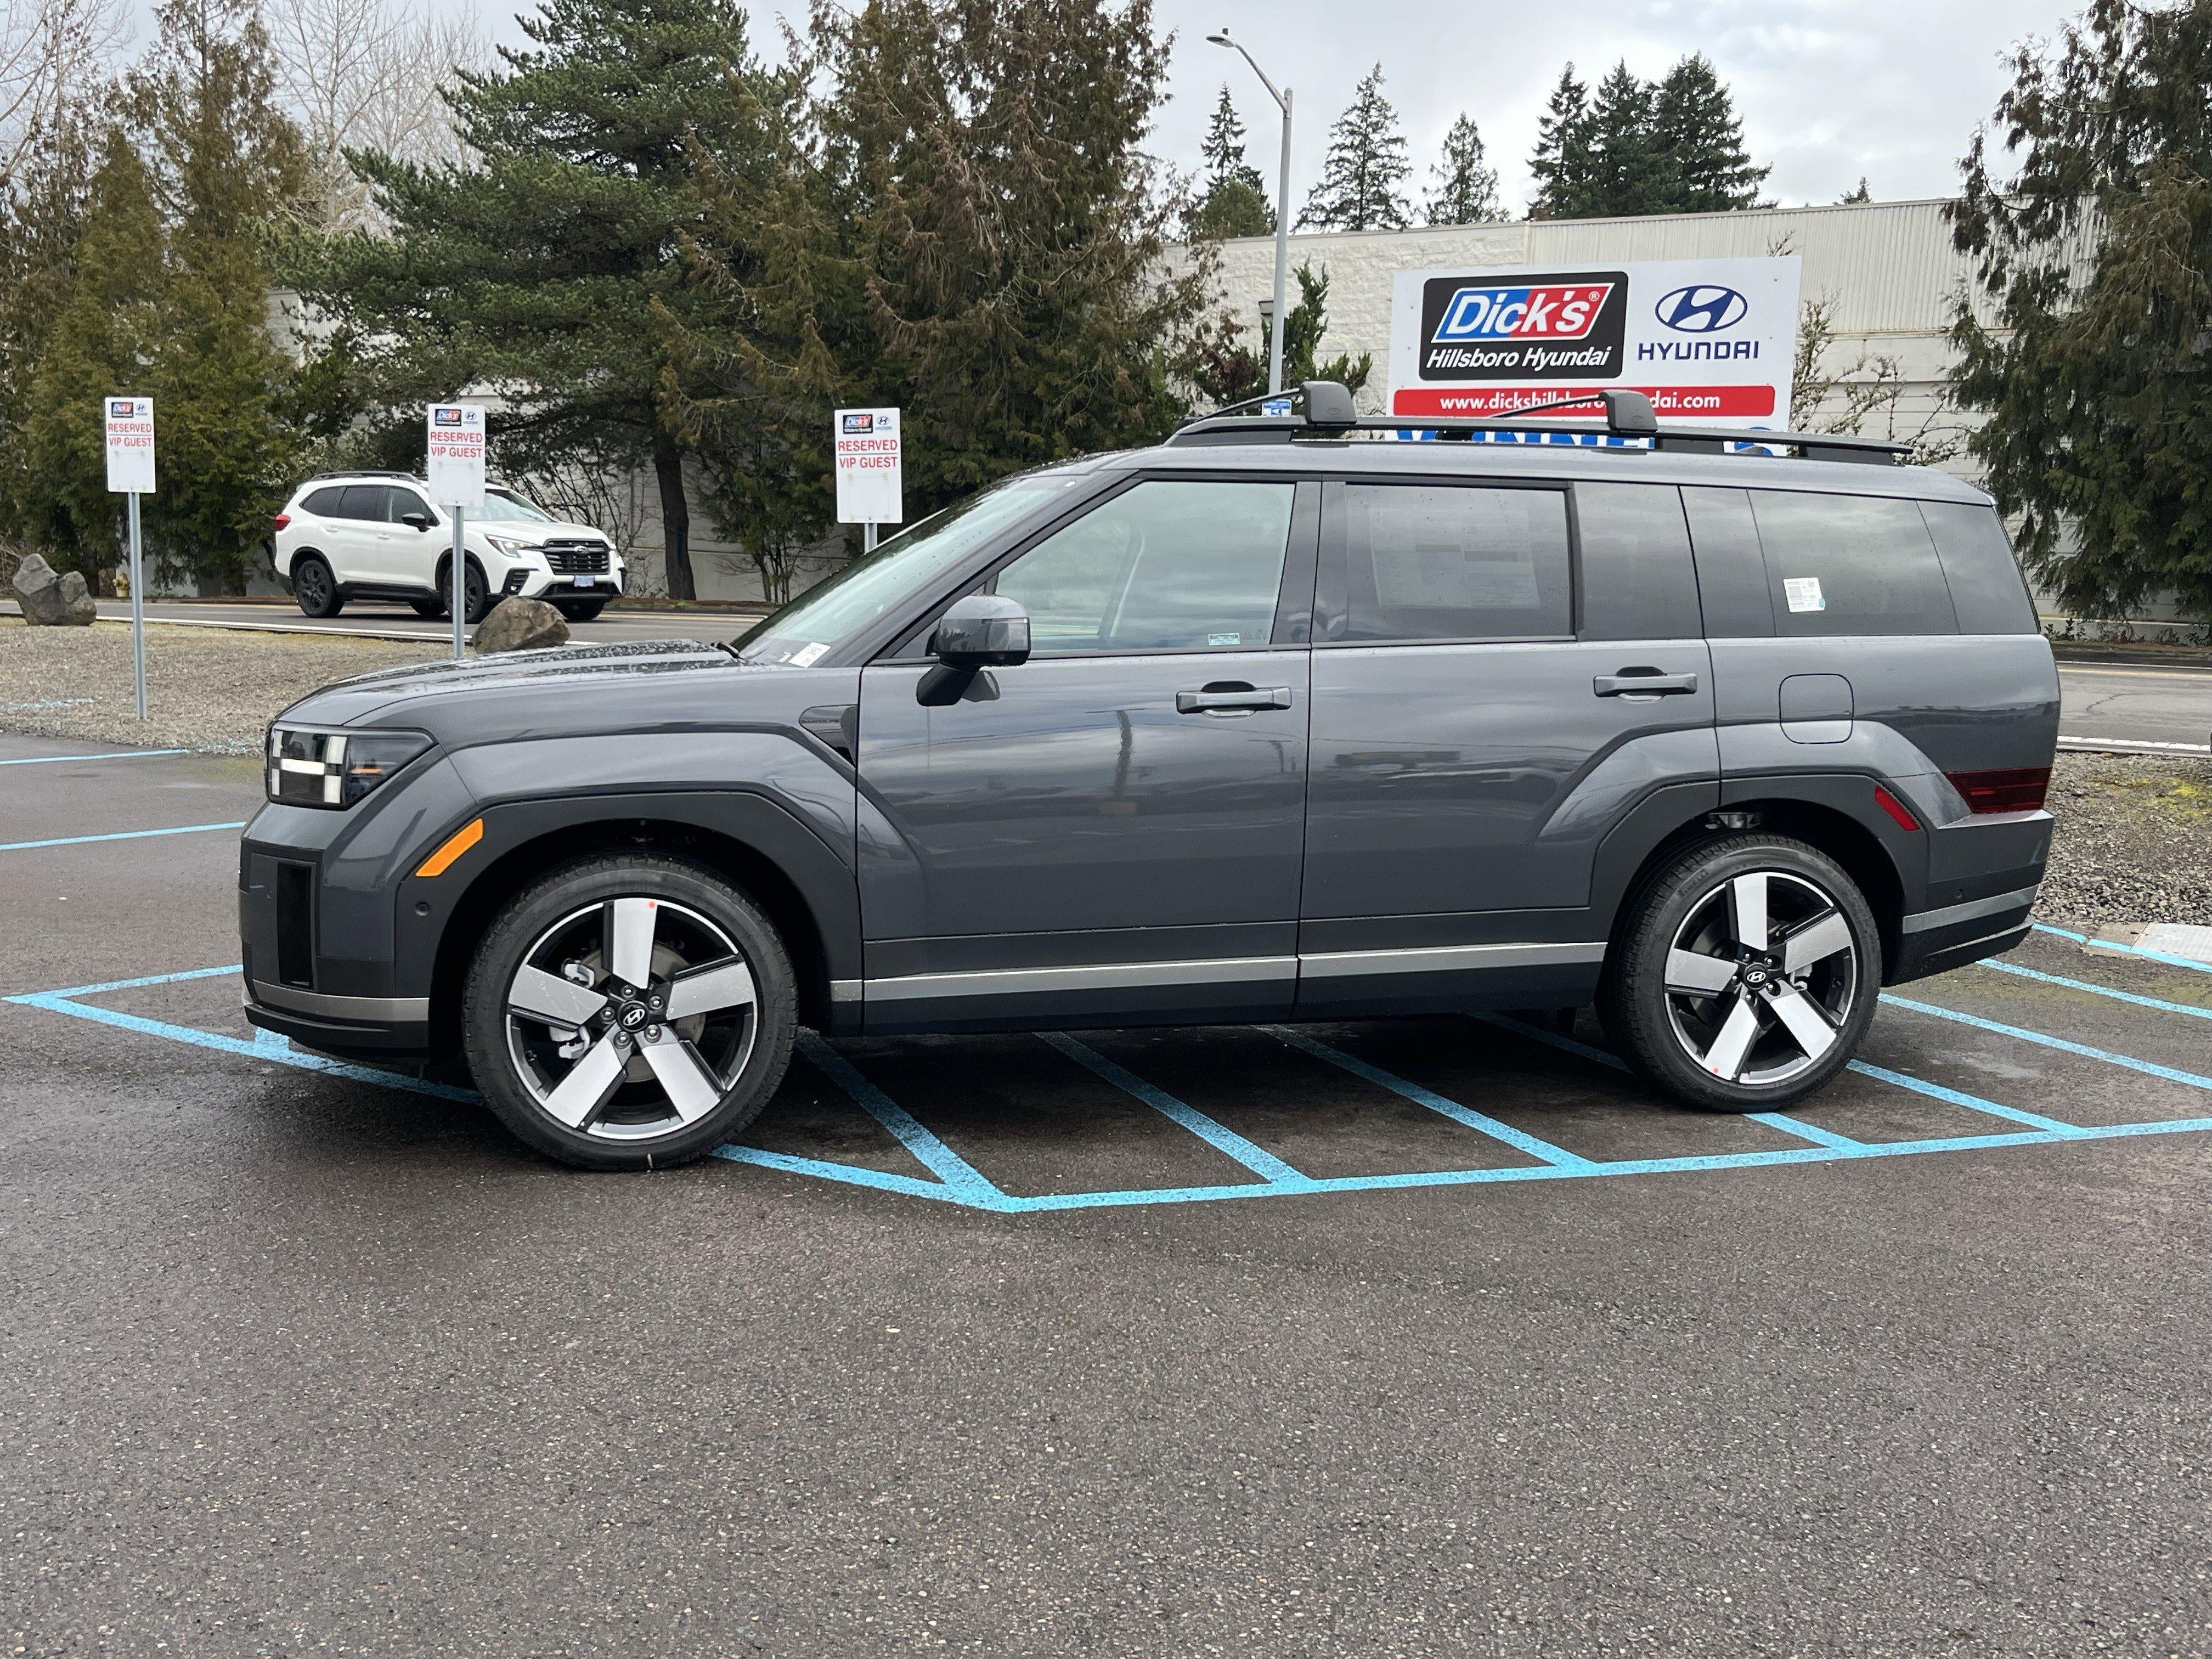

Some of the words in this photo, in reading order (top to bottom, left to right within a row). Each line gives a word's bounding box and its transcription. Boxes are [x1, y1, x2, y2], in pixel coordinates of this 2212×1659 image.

[1638, 341, 1759, 360] HYUNDAI
[1426, 348, 1519, 368] Hillsboro
[1522, 346, 1612, 371] Hyundai
[108, 422, 152, 433] RESERVED
[109, 437, 122, 447] VIP
[124, 437, 152, 447] GUEST
[430, 431, 483, 443] RESERVED
[838, 439, 898, 452] RESERVED
[431, 447, 446, 456] VIP
[449, 447, 482, 458] GUEST
[839, 457, 856, 468] VIP
[860, 456, 898, 468] GUEST
